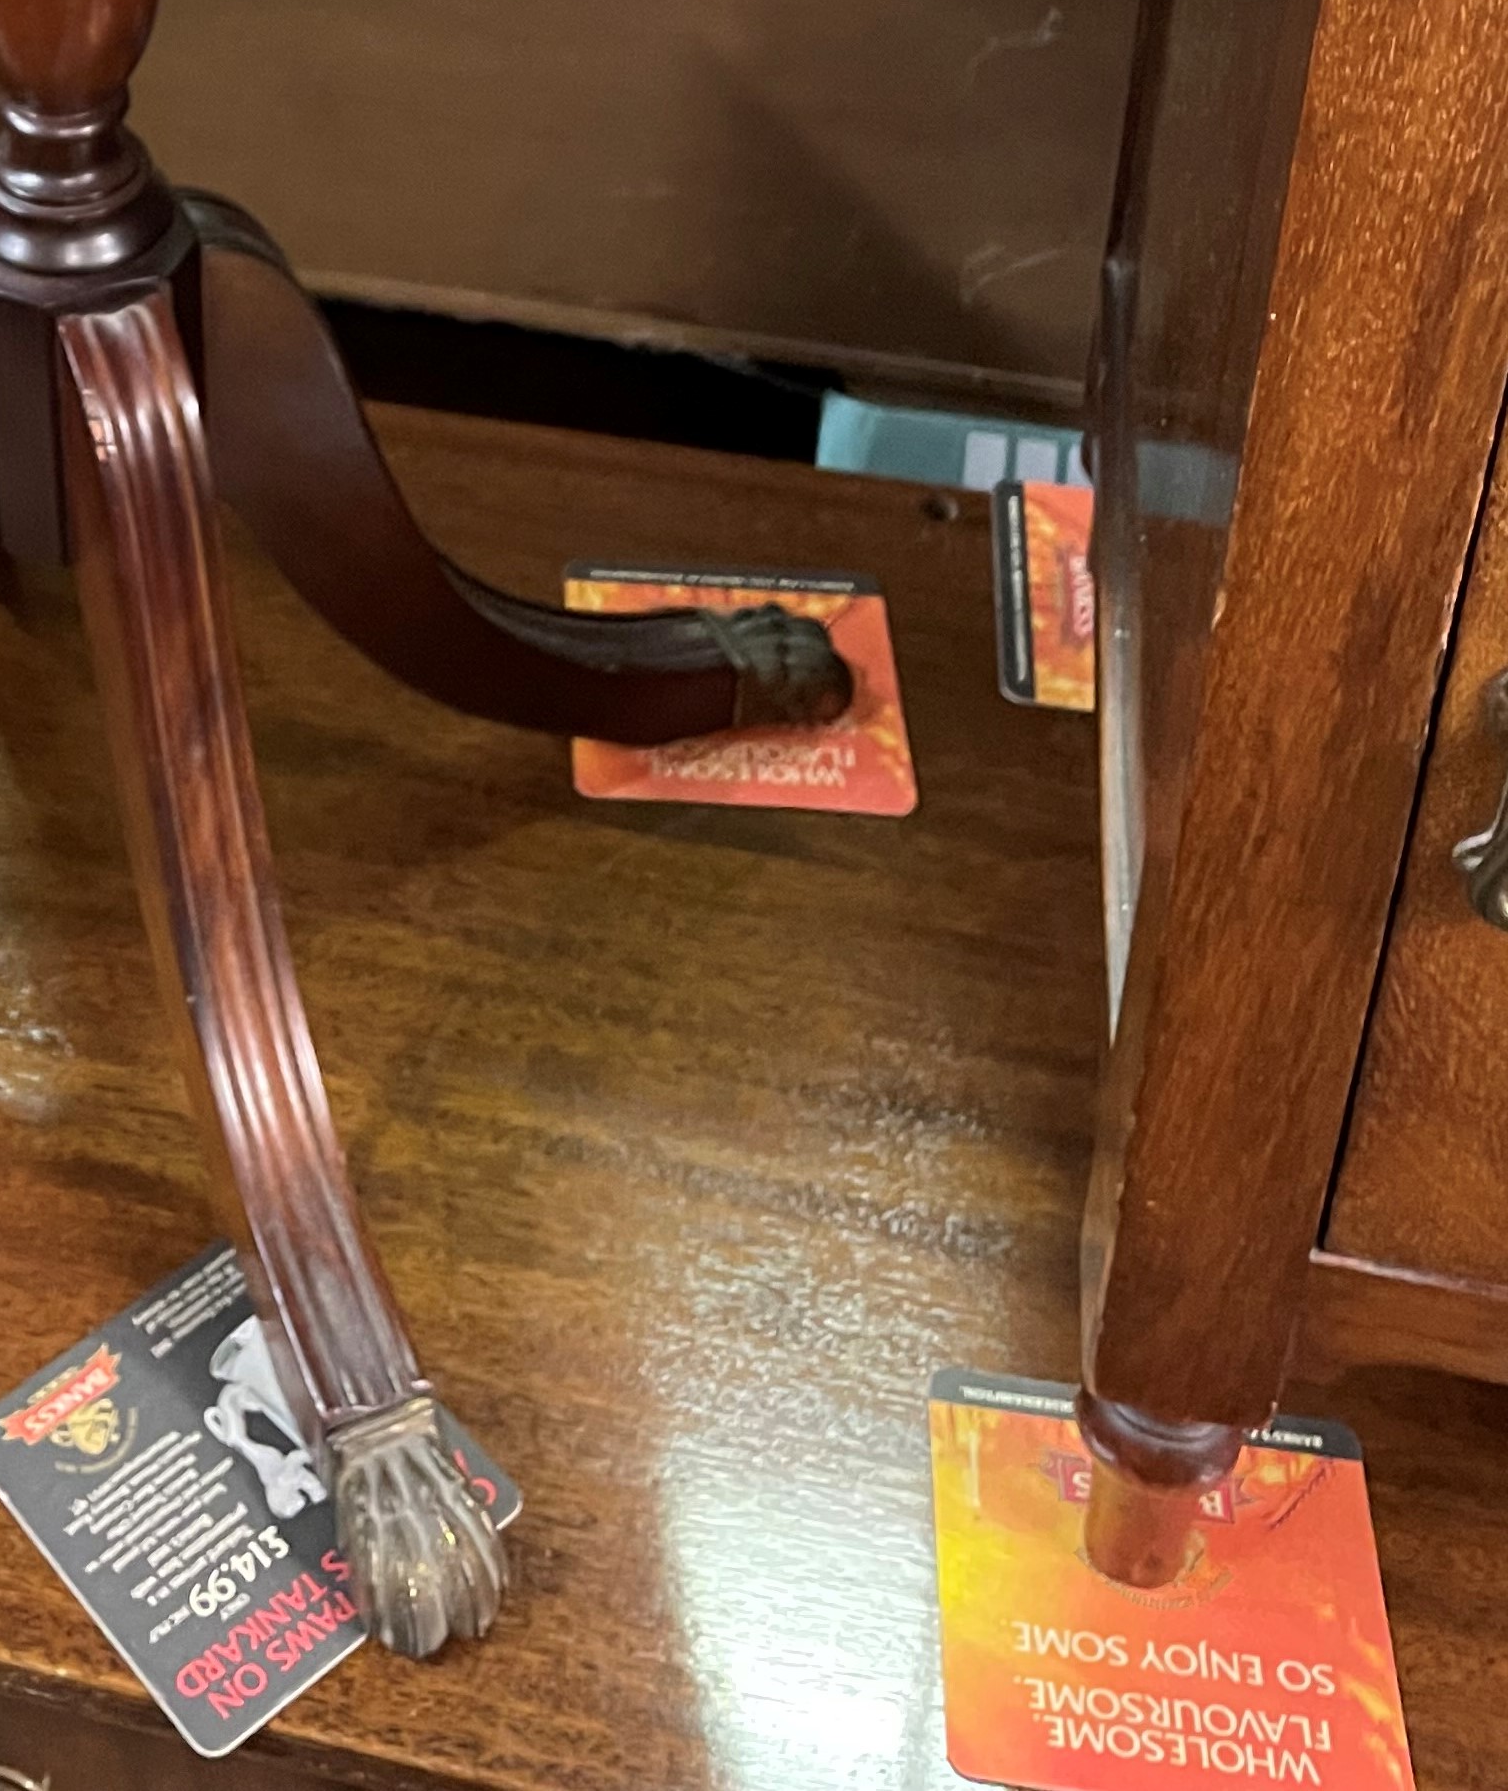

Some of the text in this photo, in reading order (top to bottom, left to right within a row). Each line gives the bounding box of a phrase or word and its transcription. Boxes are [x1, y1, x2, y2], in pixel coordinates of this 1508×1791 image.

[186, 1525, 290, 1618] £14.99
[174, 1573, 329, 1698] TANKARD
[207, 1592, 359, 1718] PAWS ON
[1000, 1620, 1336, 1696] SO ENJOY SOME.
[1014, 1677, 1330, 1751] FLAVOURSOME.
[1037, 1714, 1325, 1785] WHOLESOME.
